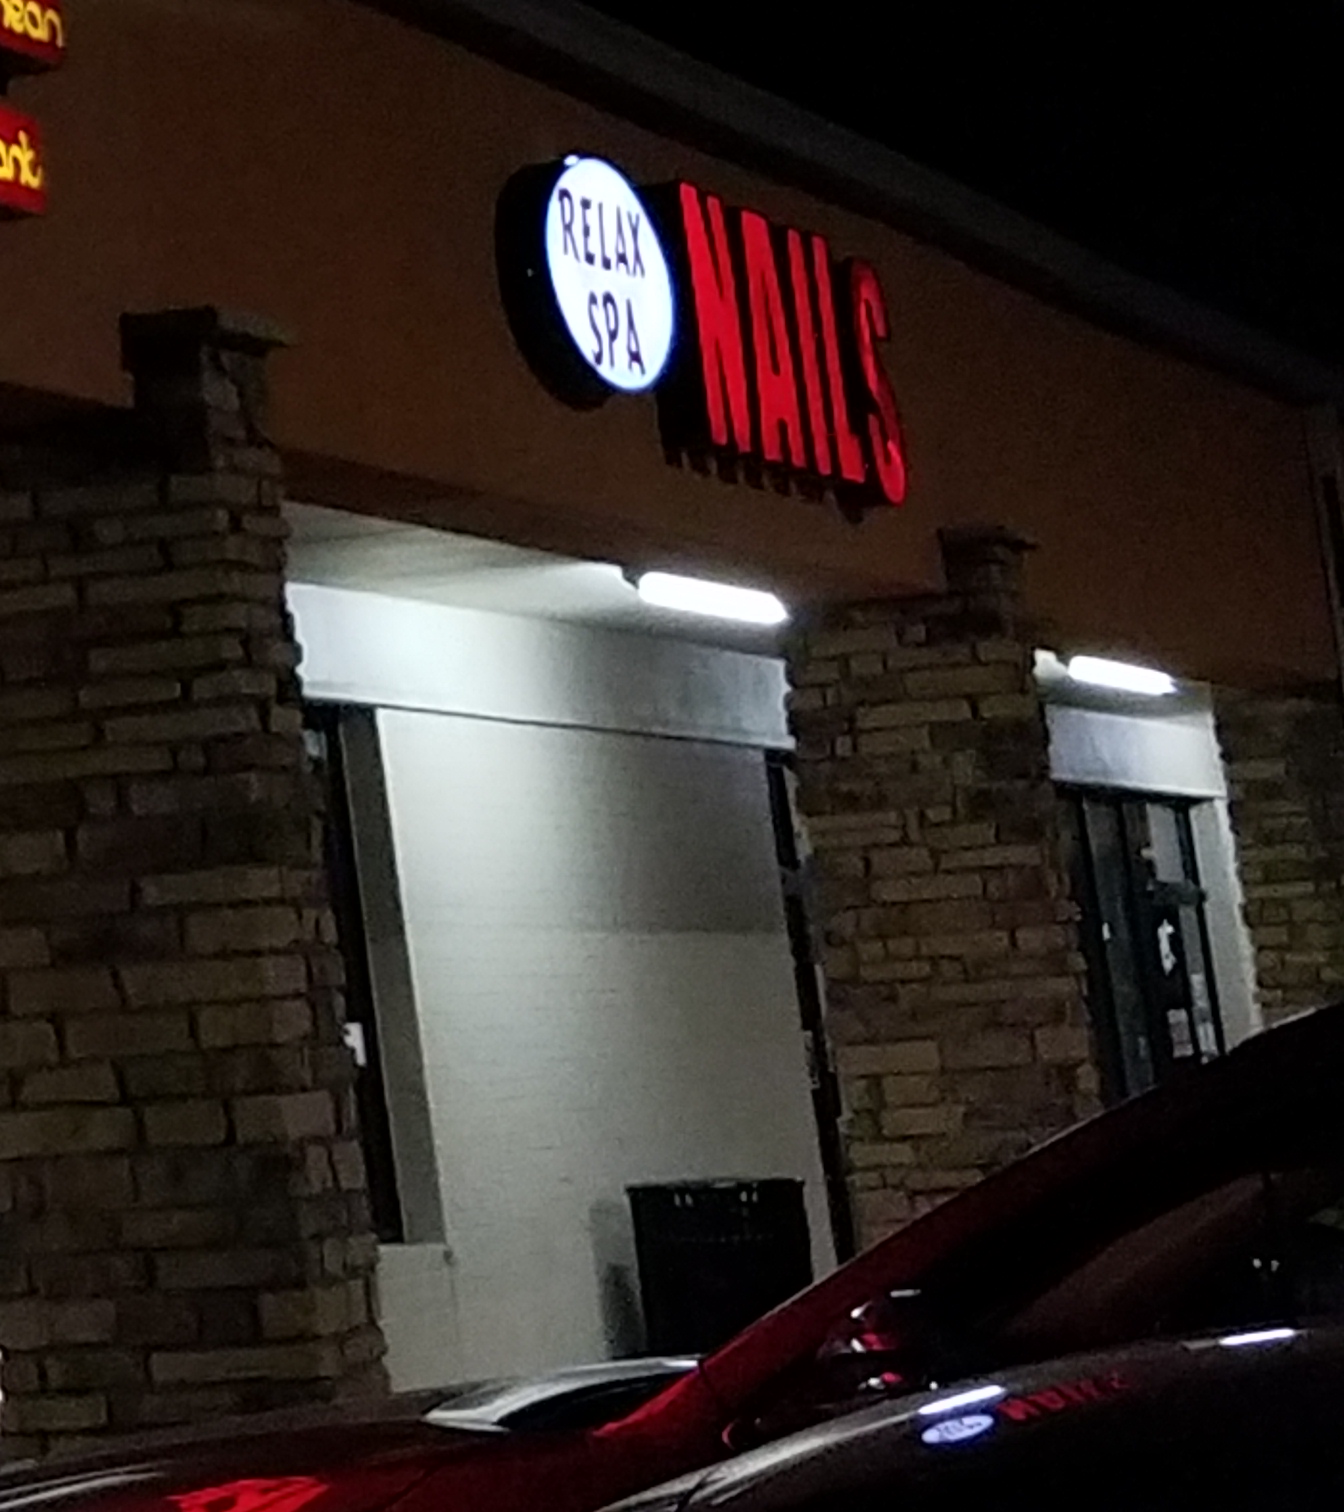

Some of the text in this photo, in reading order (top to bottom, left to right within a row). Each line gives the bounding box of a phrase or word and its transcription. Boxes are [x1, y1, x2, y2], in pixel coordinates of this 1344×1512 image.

[558, 188, 645, 278] RELAX
[587, 291, 646, 376] SPA
[678, 180, 908, 508] NAILS
